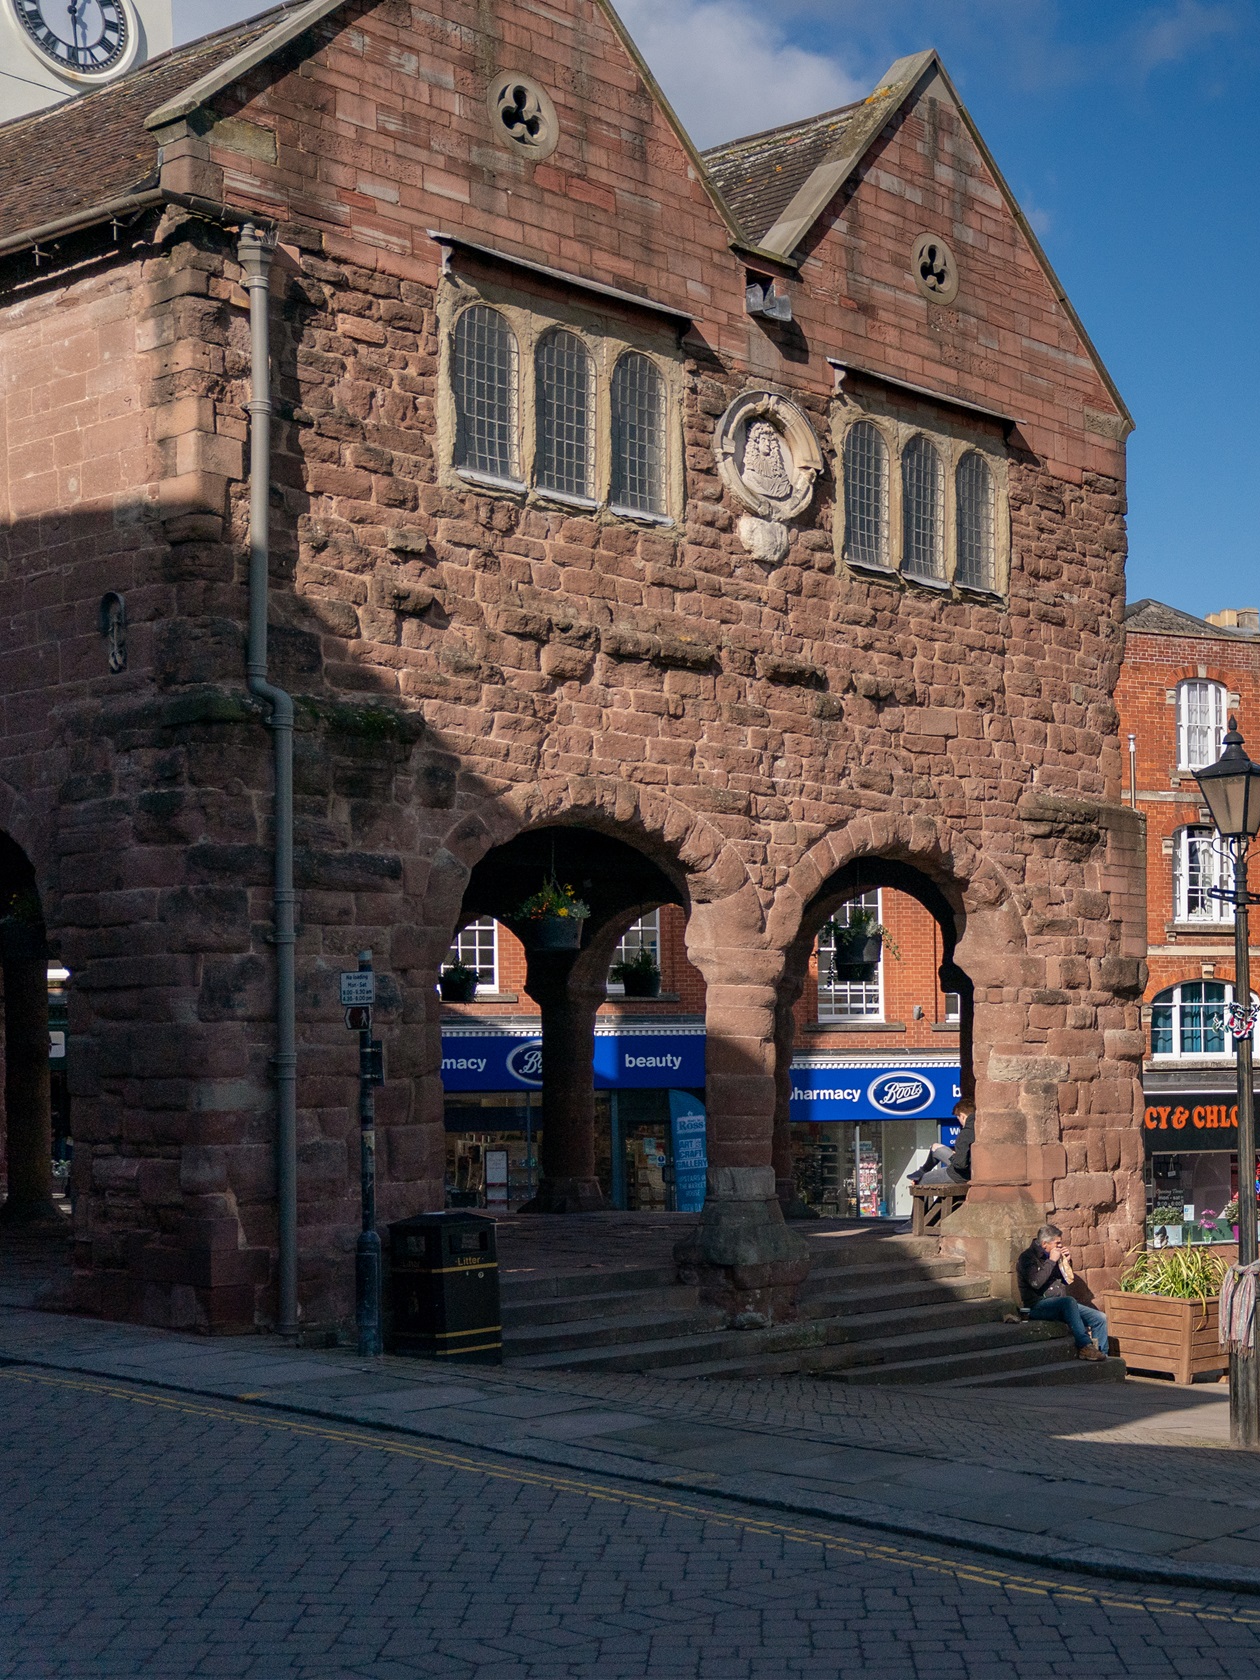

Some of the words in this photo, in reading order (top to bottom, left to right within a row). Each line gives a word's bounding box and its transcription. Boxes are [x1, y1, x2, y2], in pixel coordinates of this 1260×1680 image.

[625, 1053, 682, 1070] beauty
[879, 1081, 923, 1105] Boots
[1172, 1106, 1189, 1129] &
[679, 1121, 704, 1131] Ross
[680, 1150, 702, 1158] CRAFT
[676, 1159, 708, 1170] GALLERY
[457, 1256, 481, 1266] Litter
